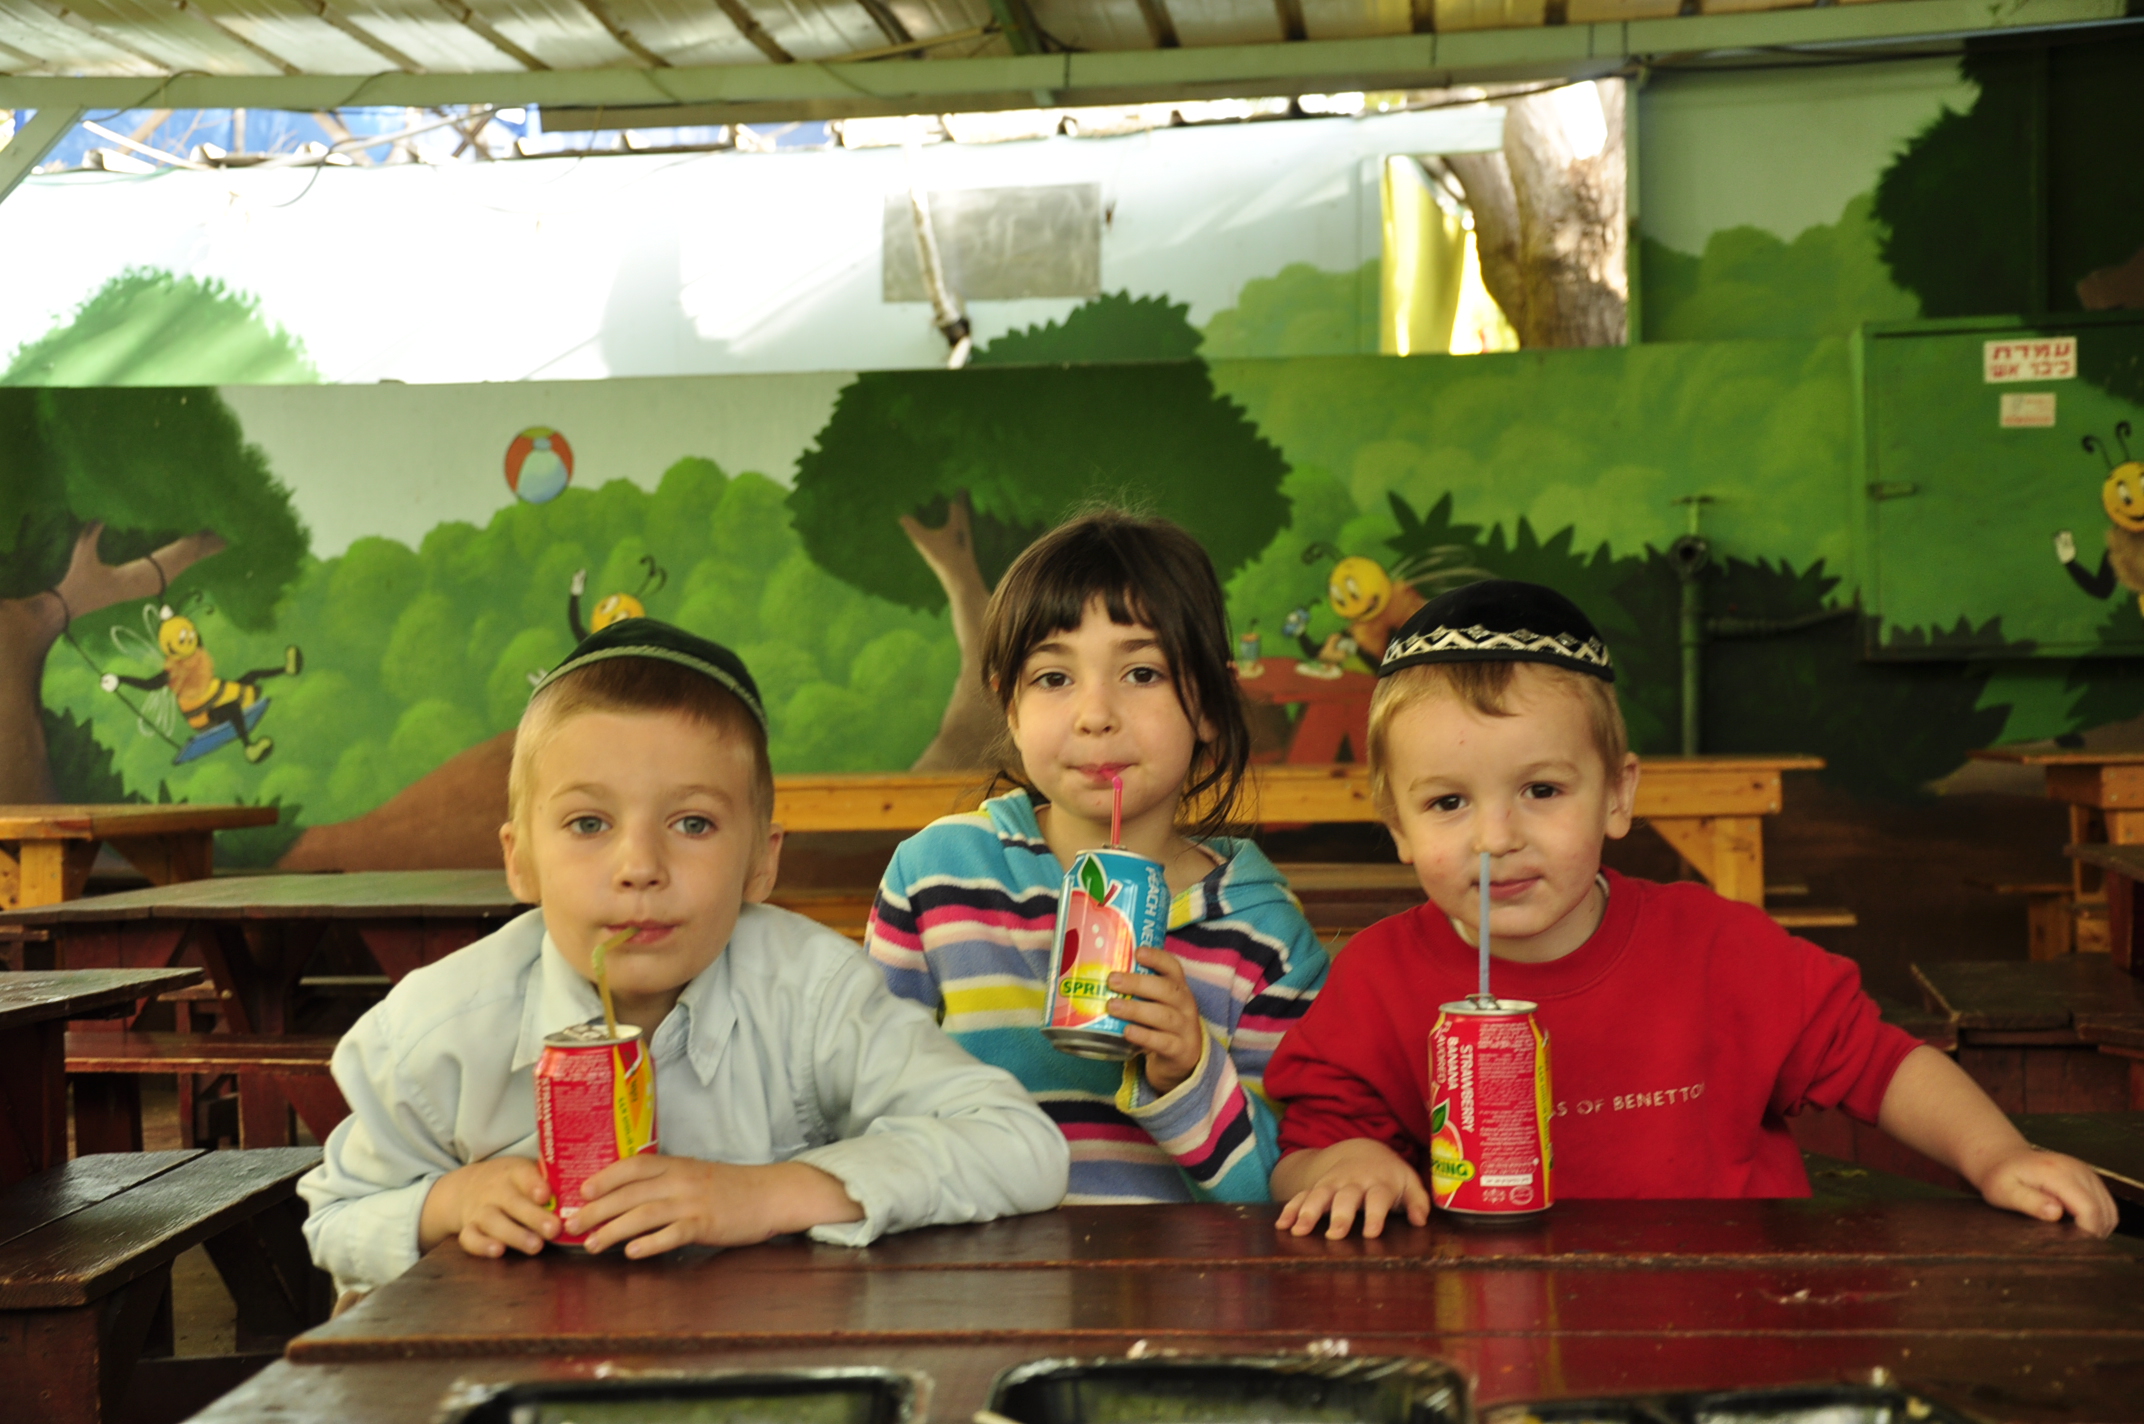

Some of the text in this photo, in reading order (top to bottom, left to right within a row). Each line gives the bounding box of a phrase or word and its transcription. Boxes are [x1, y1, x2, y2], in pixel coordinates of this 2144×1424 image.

[1145, 866, 1160, 917] PEACH
[1447, 1036, 1459, 1091] BANANA
[1460, 1044, 1475, 1133] STRAWBERRY
[1577, 1099, 1605, 1115] OF
